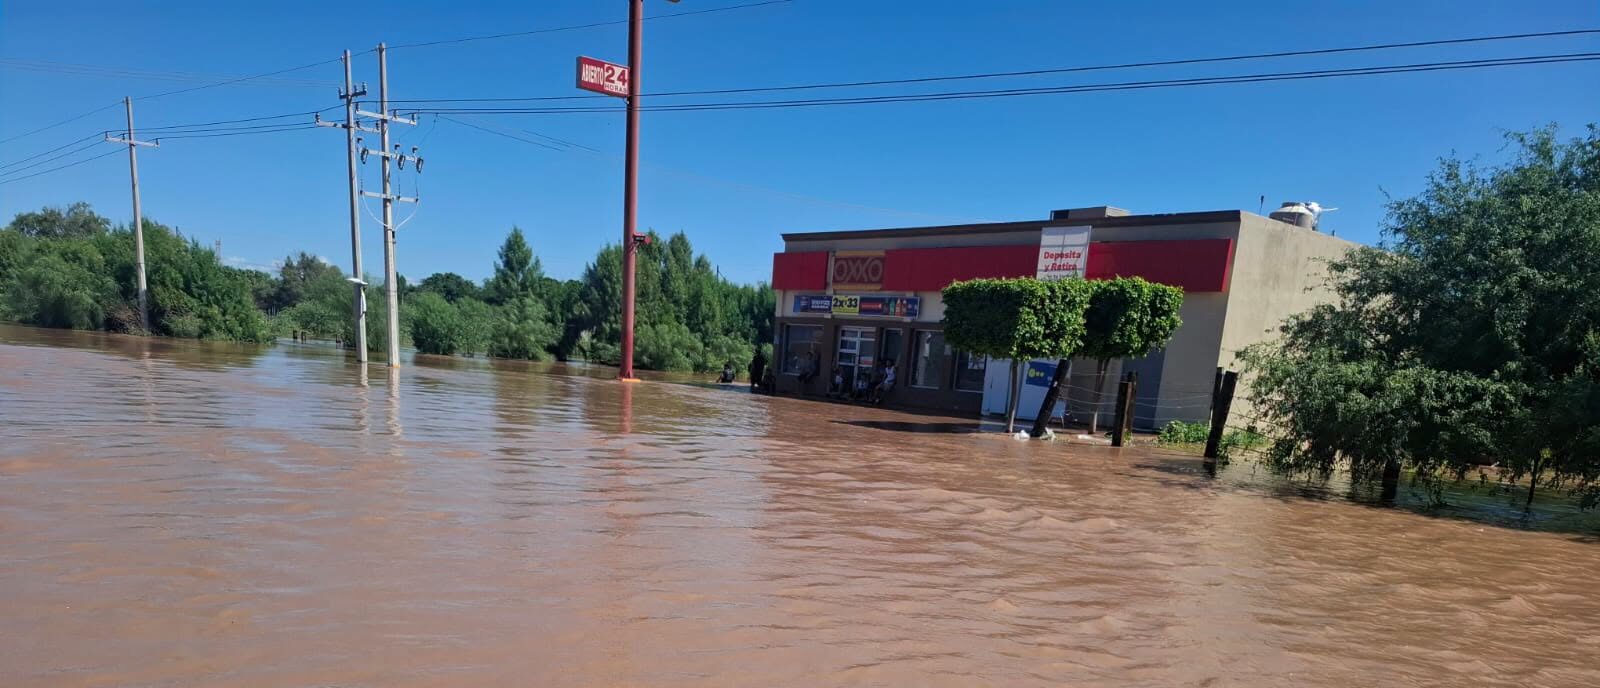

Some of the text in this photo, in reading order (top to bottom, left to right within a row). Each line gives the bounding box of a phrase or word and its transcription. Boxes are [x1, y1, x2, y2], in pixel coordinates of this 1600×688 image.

[605, 66, 627, 86] 24
[605, 84, 627, 93] HORAS
[1043, 251, 1081, 261] Deposita
[834, 258, 882, 281] OXXO
